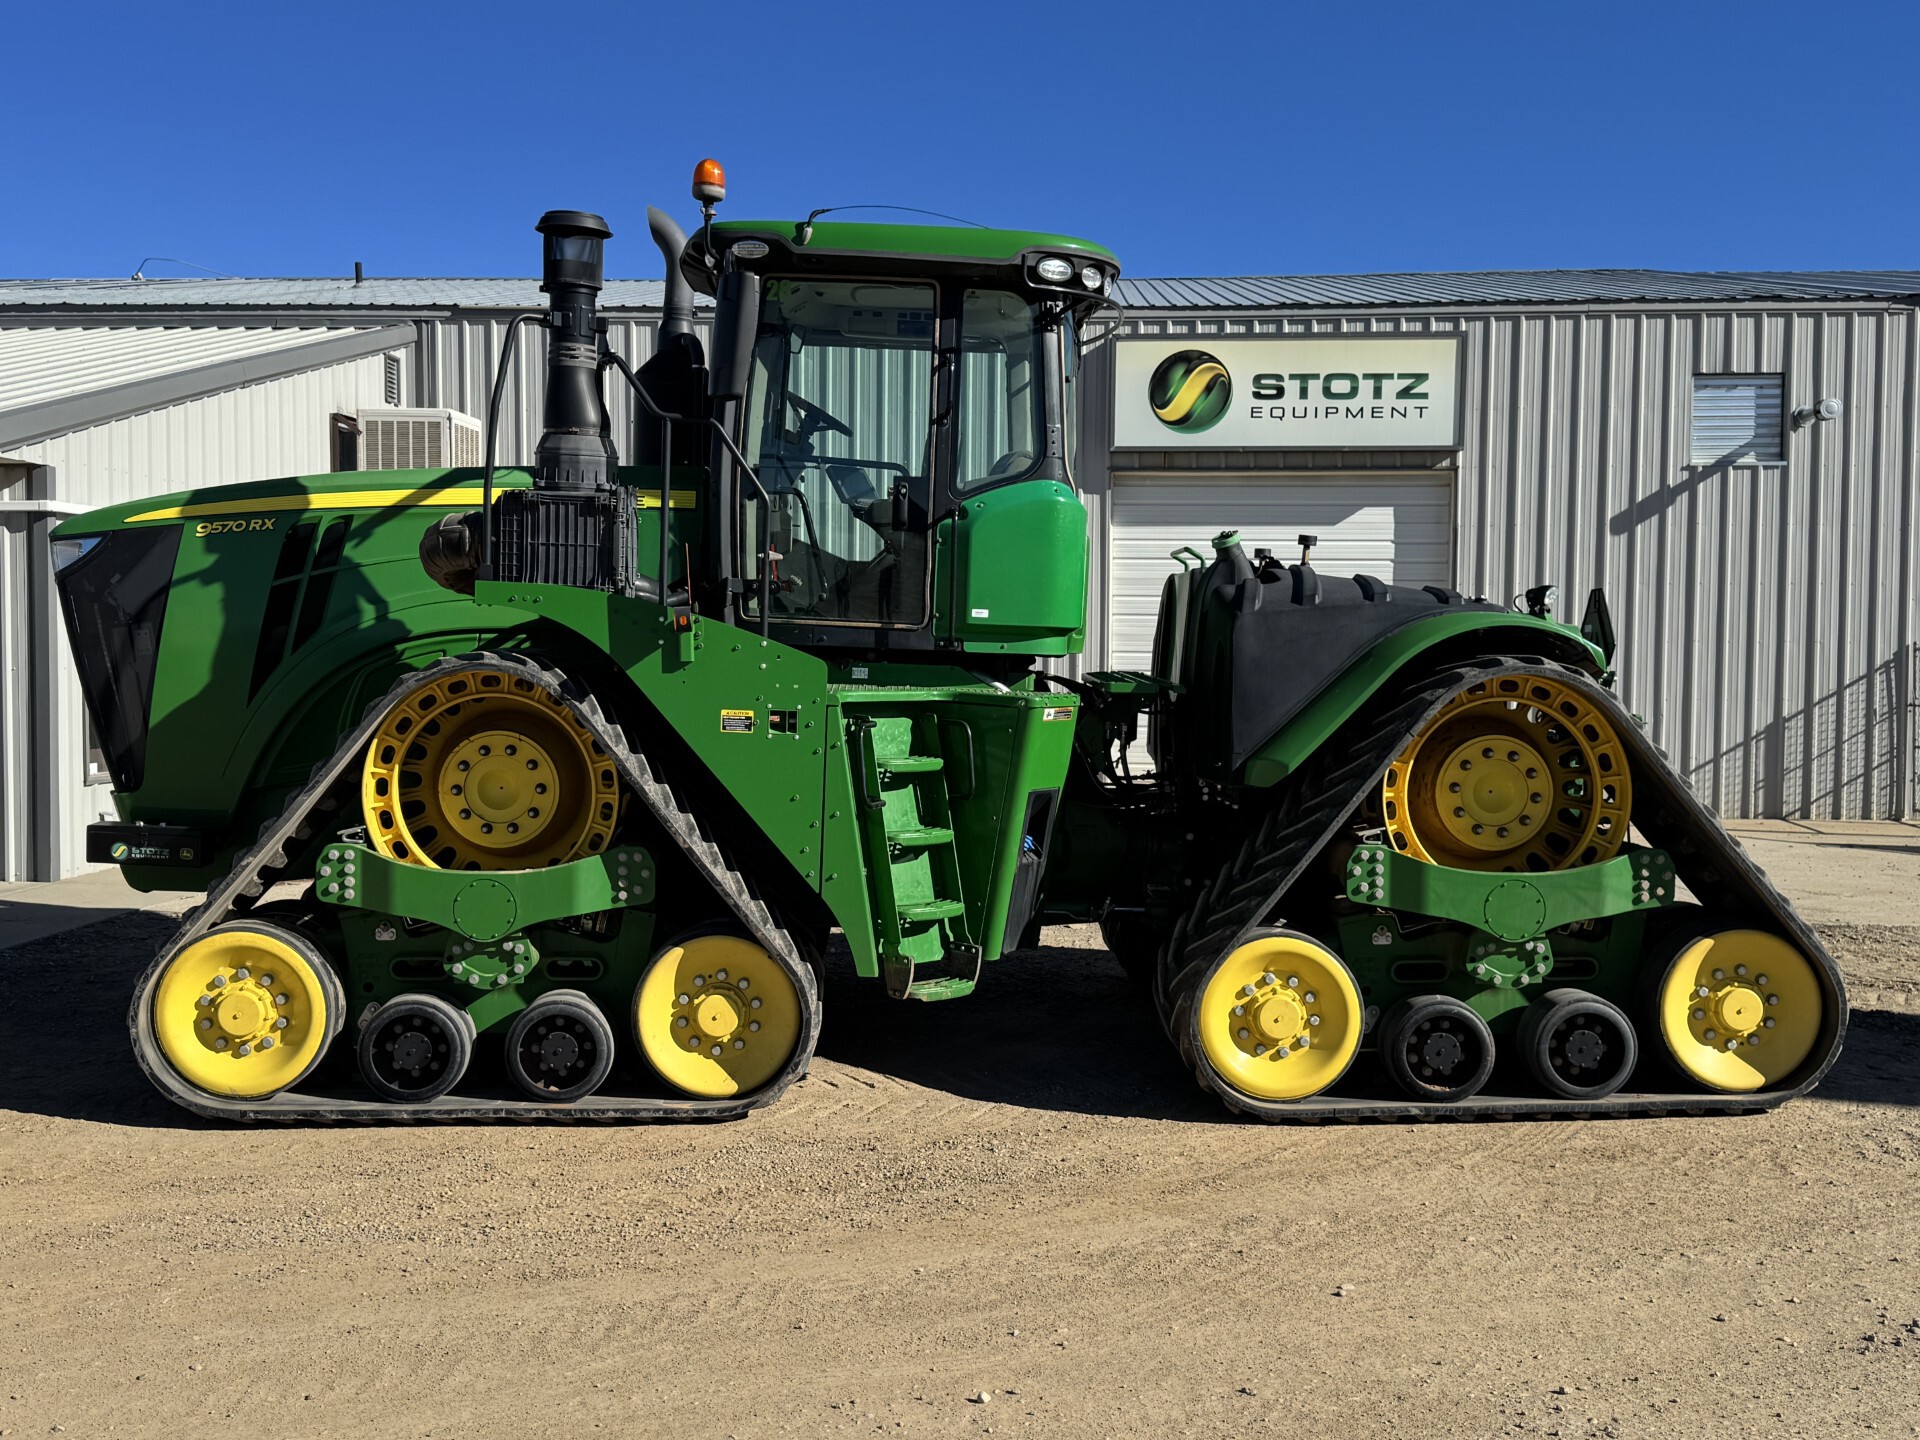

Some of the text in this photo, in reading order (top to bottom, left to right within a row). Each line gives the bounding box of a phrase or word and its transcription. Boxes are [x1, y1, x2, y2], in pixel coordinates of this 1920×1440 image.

[1251, 372, 1430, 401] STOTZ
[1250, 406, 1429, 421] EQUIPMENT
[195, 518, 277, 537] 9570 RX
[131, 847, 170, 855] STOTZ
